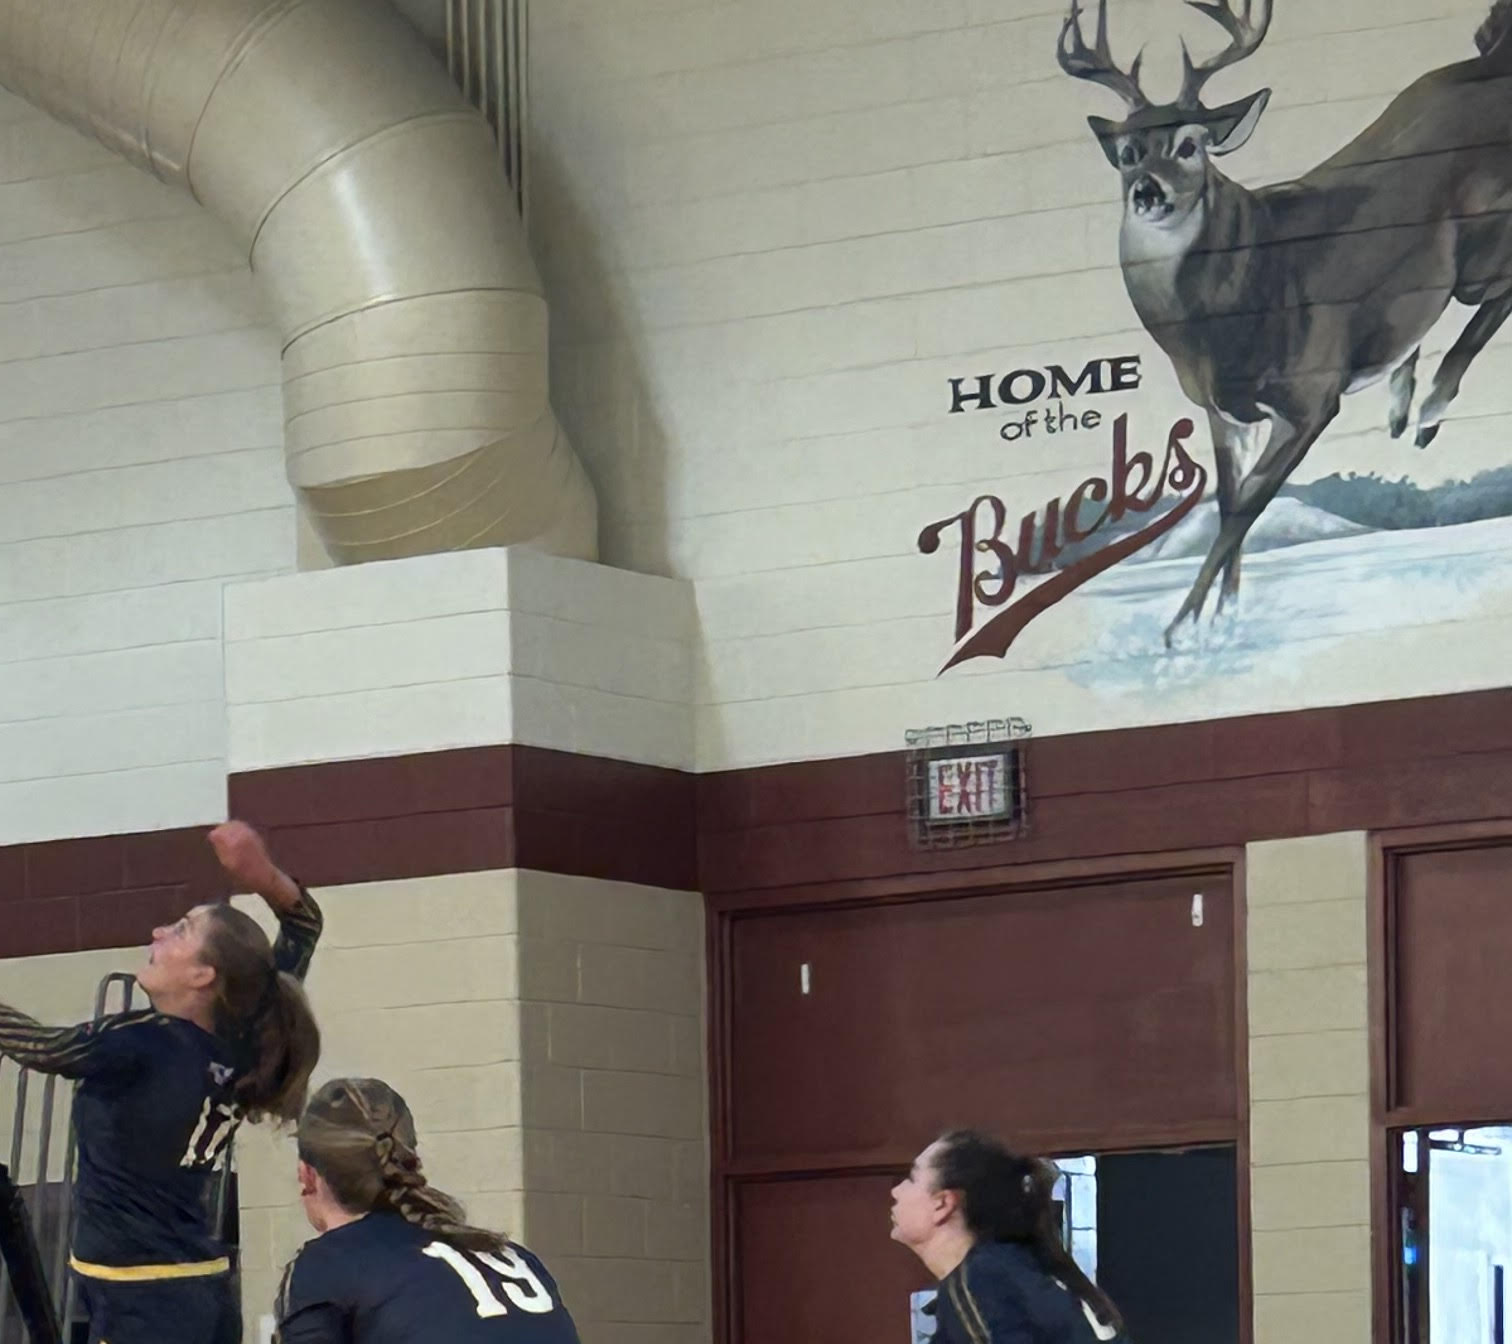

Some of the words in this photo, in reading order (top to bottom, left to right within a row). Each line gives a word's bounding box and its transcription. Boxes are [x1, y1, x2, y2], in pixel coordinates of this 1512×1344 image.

[948, 355, 1142, 413] HOME
[1000, 409, 1038, 440] of
[1044, 402, 1102, 433] the
[918, 412, 1207, 676] Bucks
[938, 760, 998, 815] EXIT
[422, 1241, 554, 1318] 19
